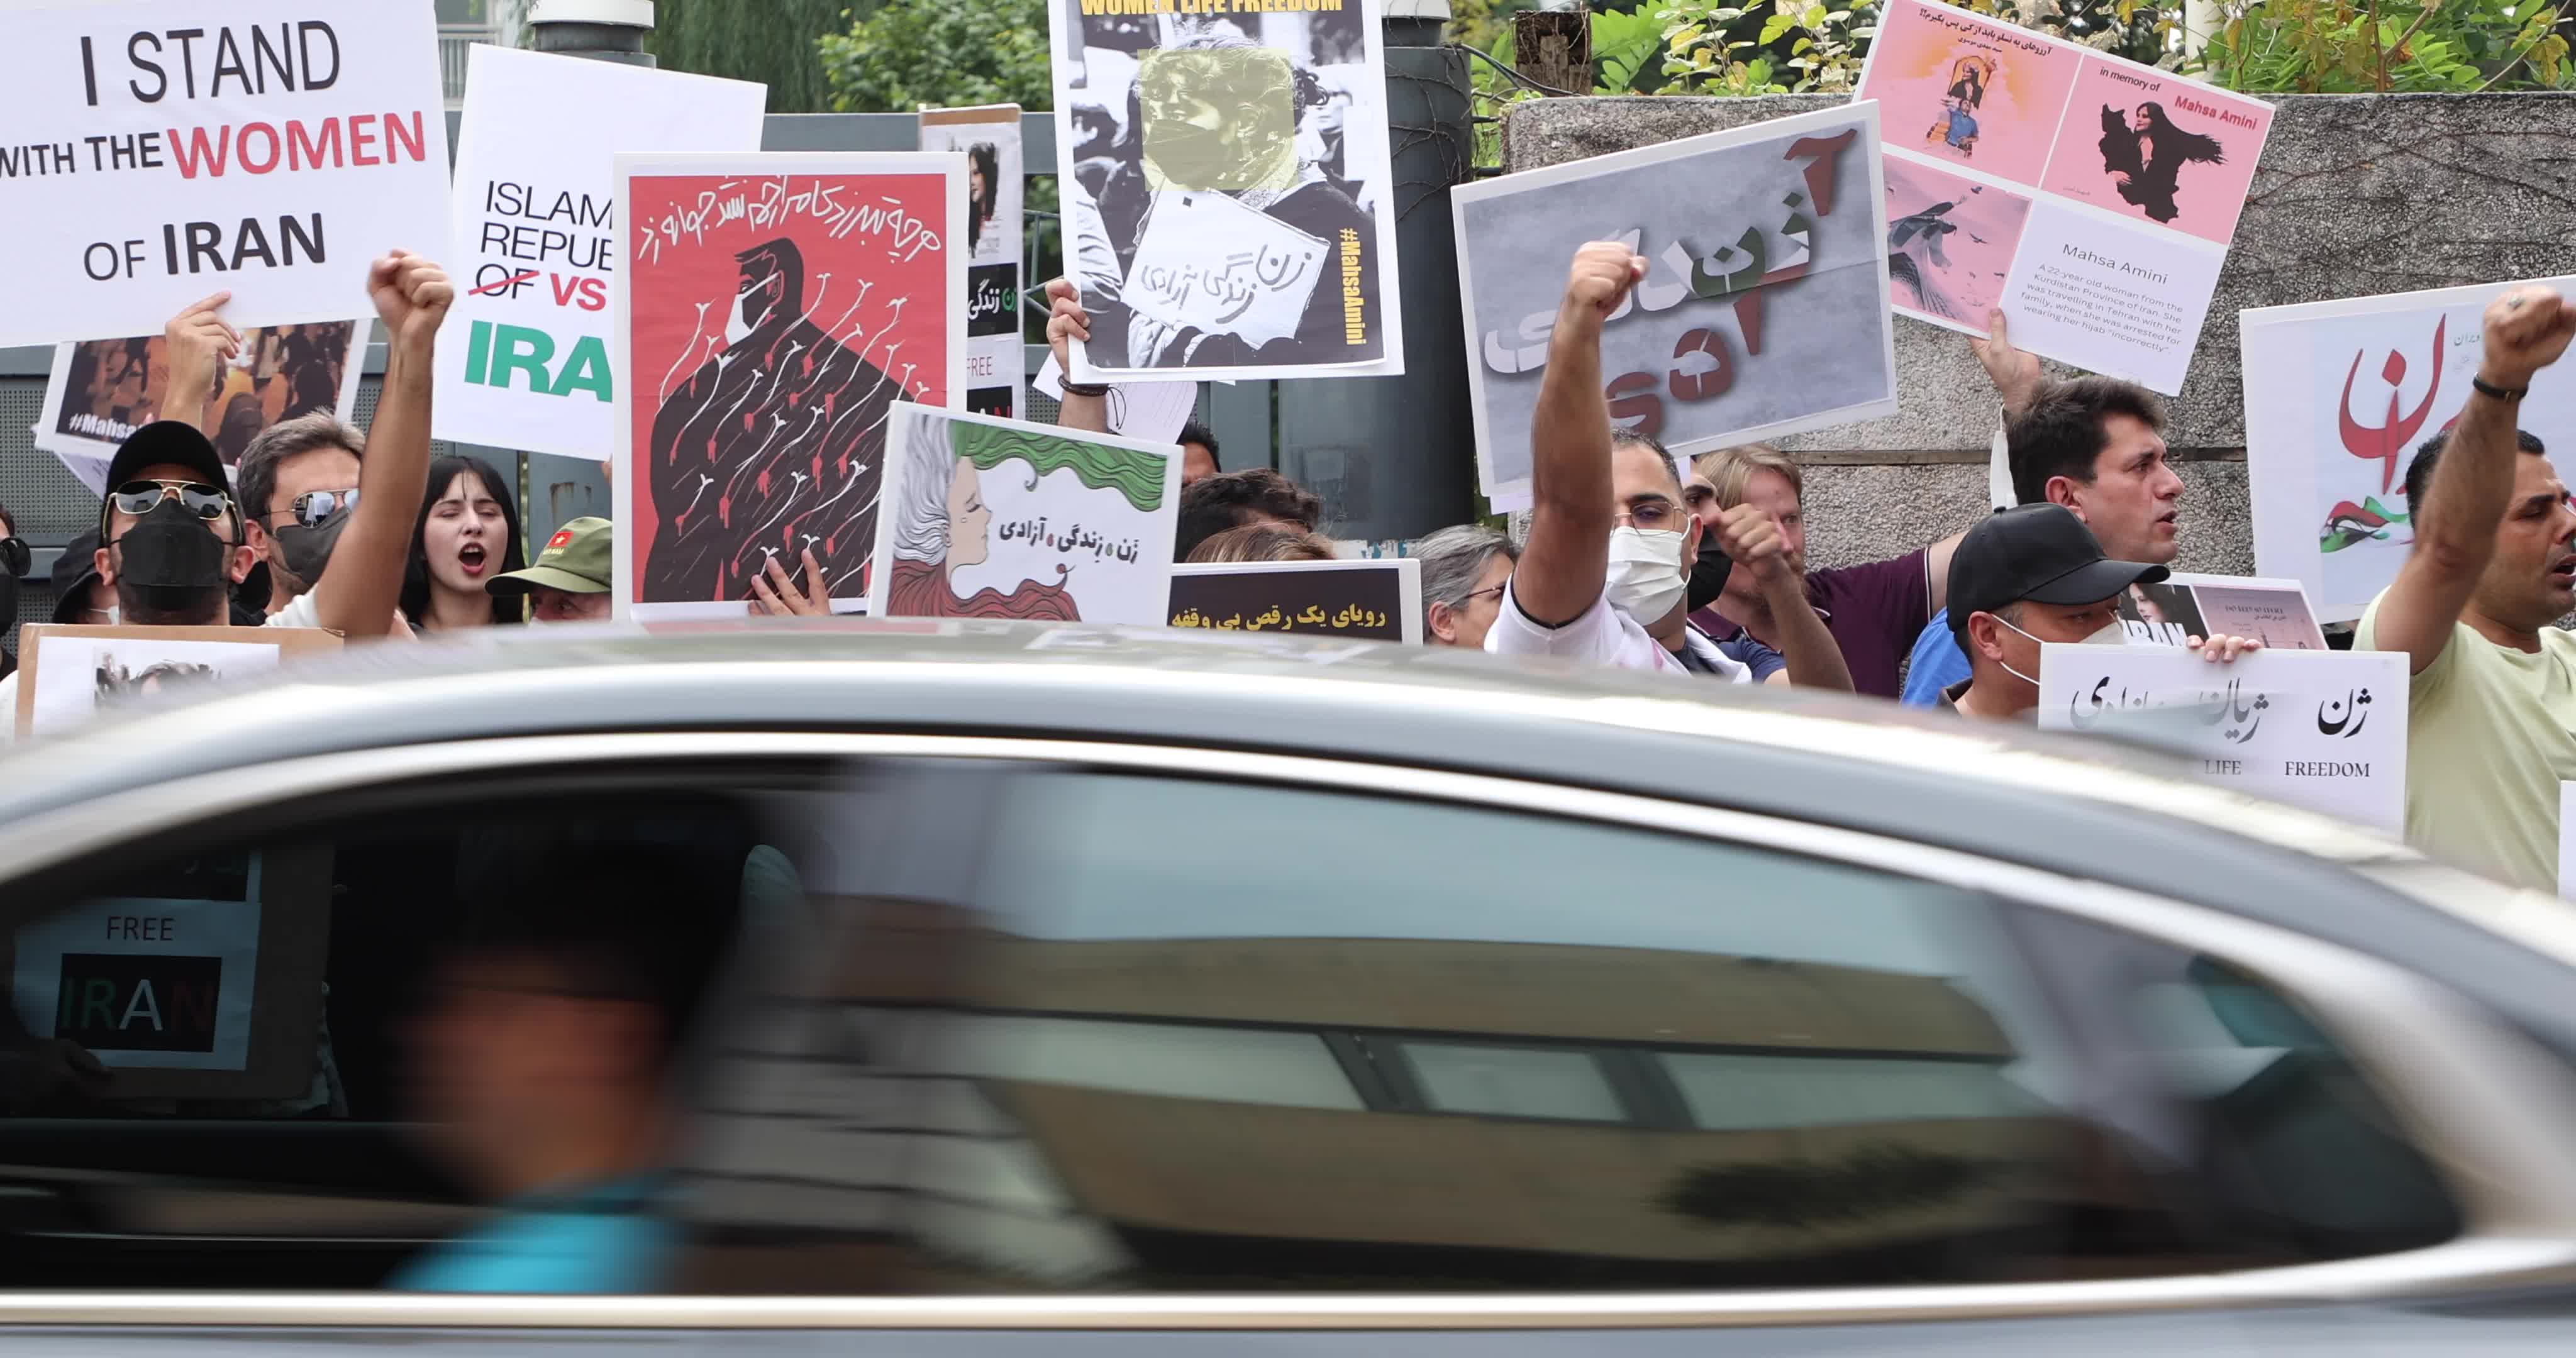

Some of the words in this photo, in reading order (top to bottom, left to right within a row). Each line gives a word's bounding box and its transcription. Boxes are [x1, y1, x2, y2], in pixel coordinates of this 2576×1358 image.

[80, 36, 97, 106] I
[128, 20, 340, 104] STAND
[2100, 67, 2109, 77] in
[2110, 72, 2148, 92] memory
[2150, 82, 2161, 92] of
[2175, 95, 2217, 118] Mahsa
[2219, 109, 2258, 130] Amini
[85, 132, 164, 171] THE
[167, 111, 426, 179] WOMEN
[485, 180, 613, 229] ISLAM
[83, 240, 146, 282] OF
[163, 213, 326, 275] IRAN
[1256, 244, 1312, 292] زن
[2063, 243, 2116, 270] Mahsa
[2120, 262, 2169, 285] Amini
[475, 263, 535, 300] OF
[550, 272, 607, 311] VS
[1340, 228, 1367, 345] #MahsaAmini
[2027, 283, 2045, 294] was
[2048, 289, 2093, 310] travelling
[2095, 303, 2104, 312] in
[2107, 306, 2140, 323] Tehran
[2142, 318, 2163, 329] with
[2165, 324, 2182, 335] her
[2034, 273, 2080, 292] Kurdistan
[2082, 288, 2124, 307] Province
[2126, 301, 2138, 310] of
[2163, 312, 2182, 324] She
[2086, 277, 2102, 289] old
[2104, 284, 2139, 299] woman
[2141, 295, 2164, 308] from
[2167, 302, 2184, 313] the
[2021, 291, 2053, 308] family,
[2055, 303, 2082, 315] when
[2083, 312, 2101, 322] she
[2102, 318, 2121, 328] was
[2123, 324, 2165, 341] arrested
[2167, 334, 2182, 346] for
[2023, 306, 2061, 323] wearing
[2063, 315, 2079, 327] her
[2082, 321, 2106, 335] hijab
[464, 319, 613, 404] IRA
[69, 413, 143, 439] #Mahsa
[999, 517, 1048, 547] آزادی
[1246, 605, 1292, 631] رقص
[1297, 605, 1326, 627] یک
[1331, 604, 1386, 627] رویای
[2318, 688, 2372, 738] ژن
[2205, 759, 2241, 776] LIFE
[2285, 761, 2370, 777] FREEDOM
[106, 915, 175, 941] FREE
